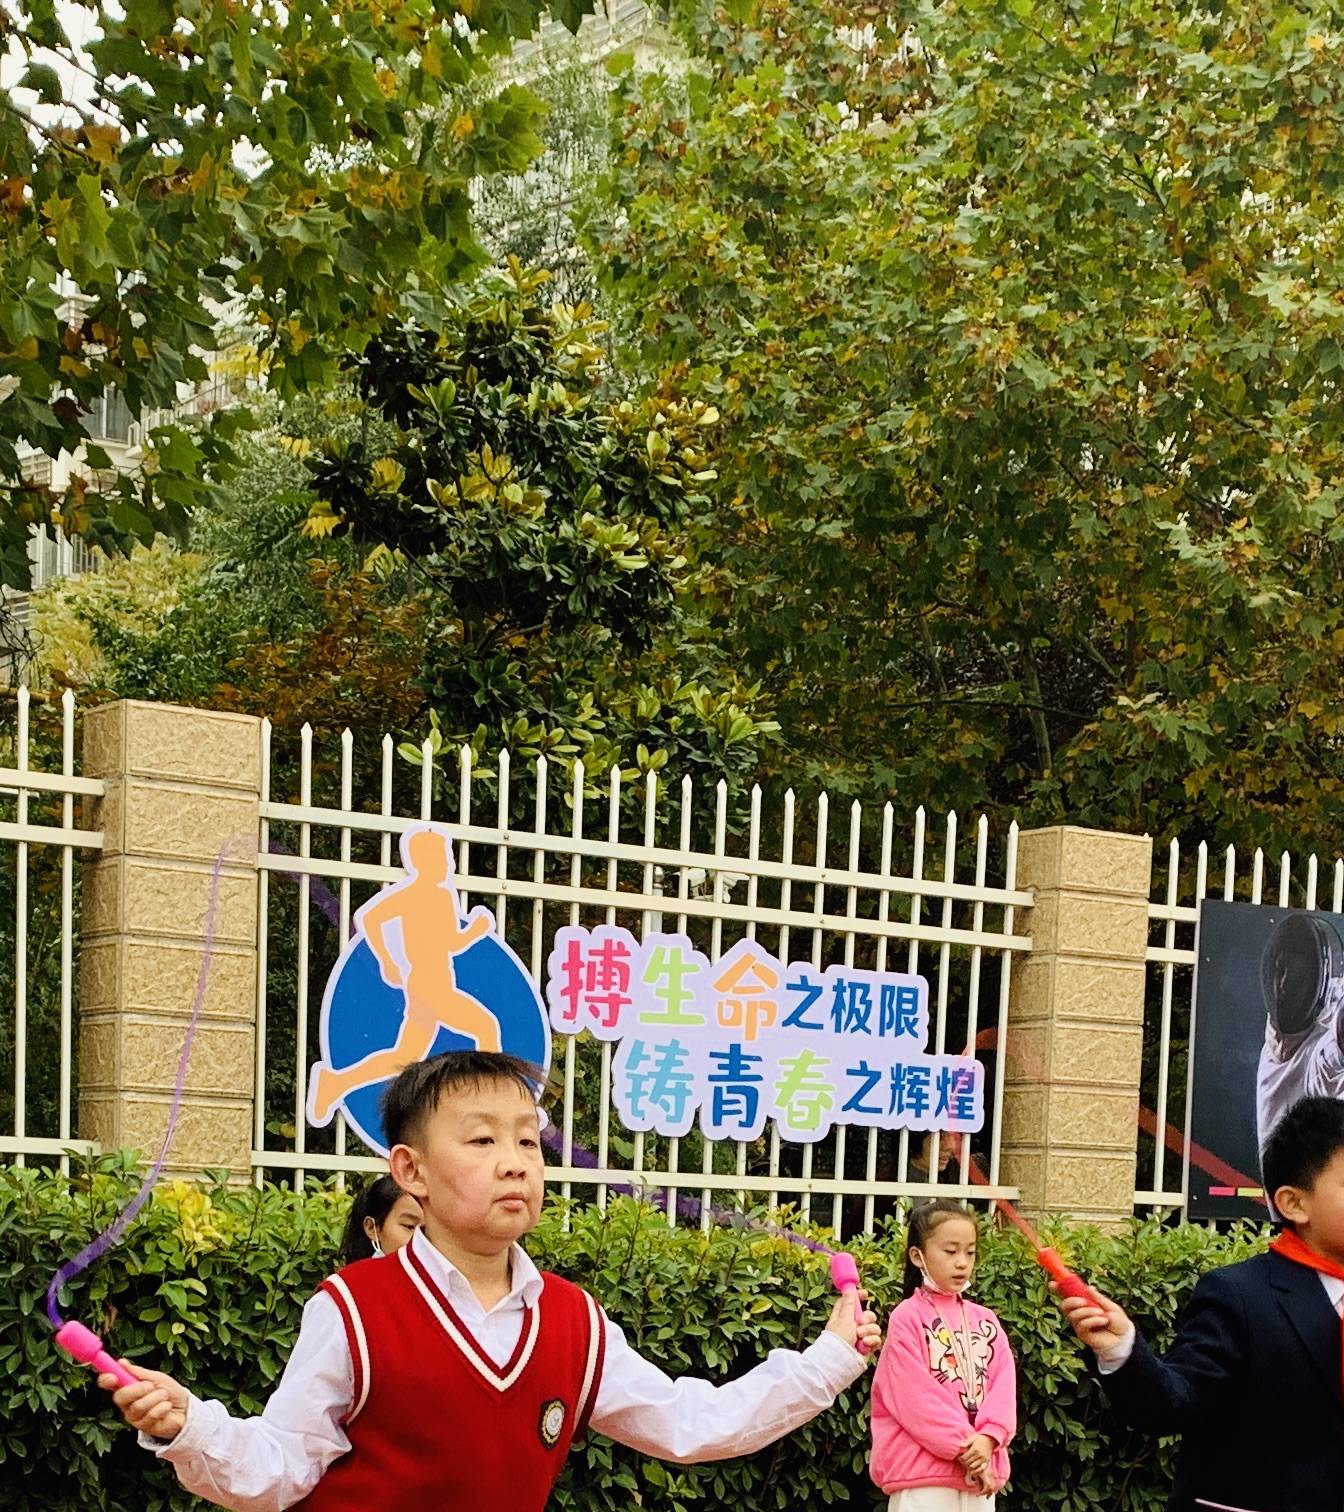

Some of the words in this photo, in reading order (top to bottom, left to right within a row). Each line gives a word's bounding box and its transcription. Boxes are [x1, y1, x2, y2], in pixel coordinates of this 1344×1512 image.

[560, 939, 919, 1041] 搏生命之极限
[624, 1038, 976, 1132] 铸青春之辉煌
